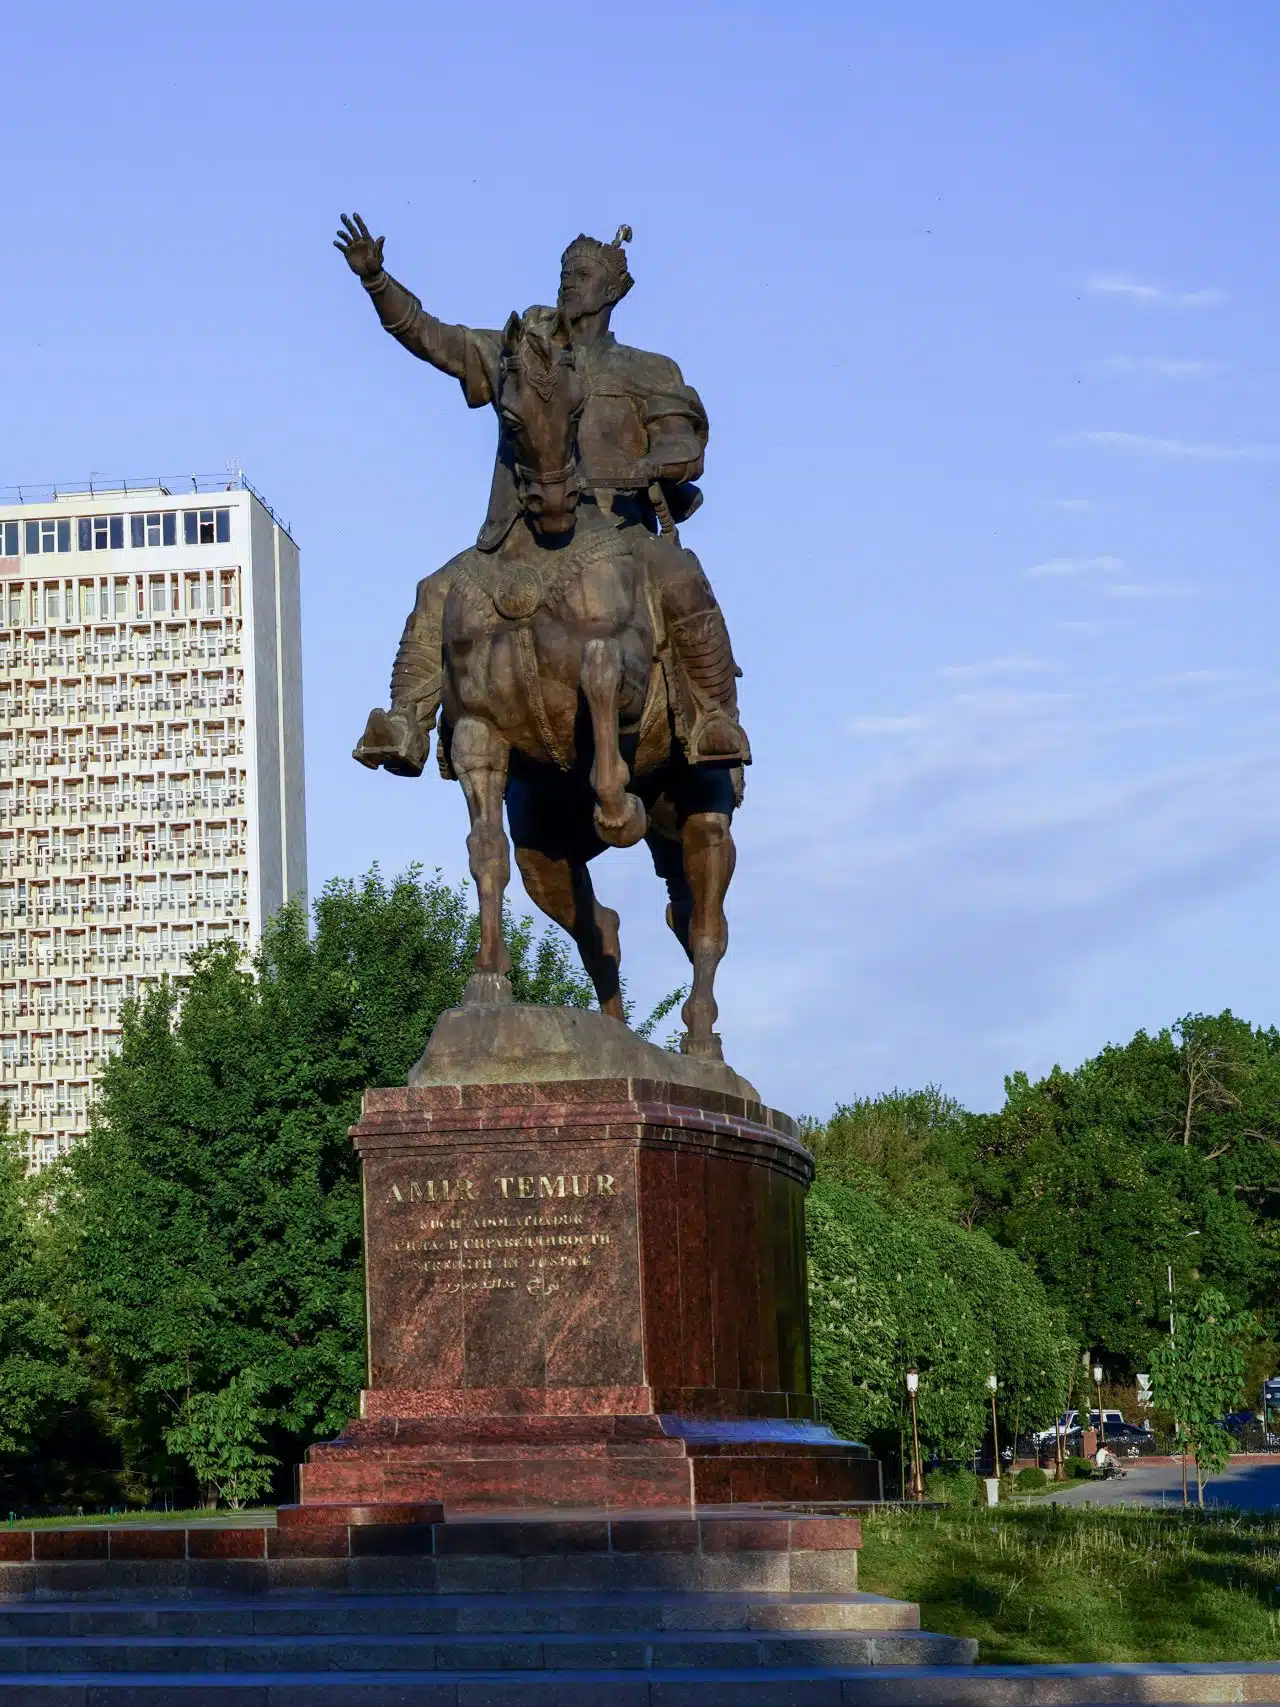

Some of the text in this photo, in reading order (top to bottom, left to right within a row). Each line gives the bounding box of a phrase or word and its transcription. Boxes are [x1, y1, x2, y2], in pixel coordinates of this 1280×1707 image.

[385, 1174, 618, 1204] AMIR TEMUR
[528, 1255, 592, 1269] JUSTICE
